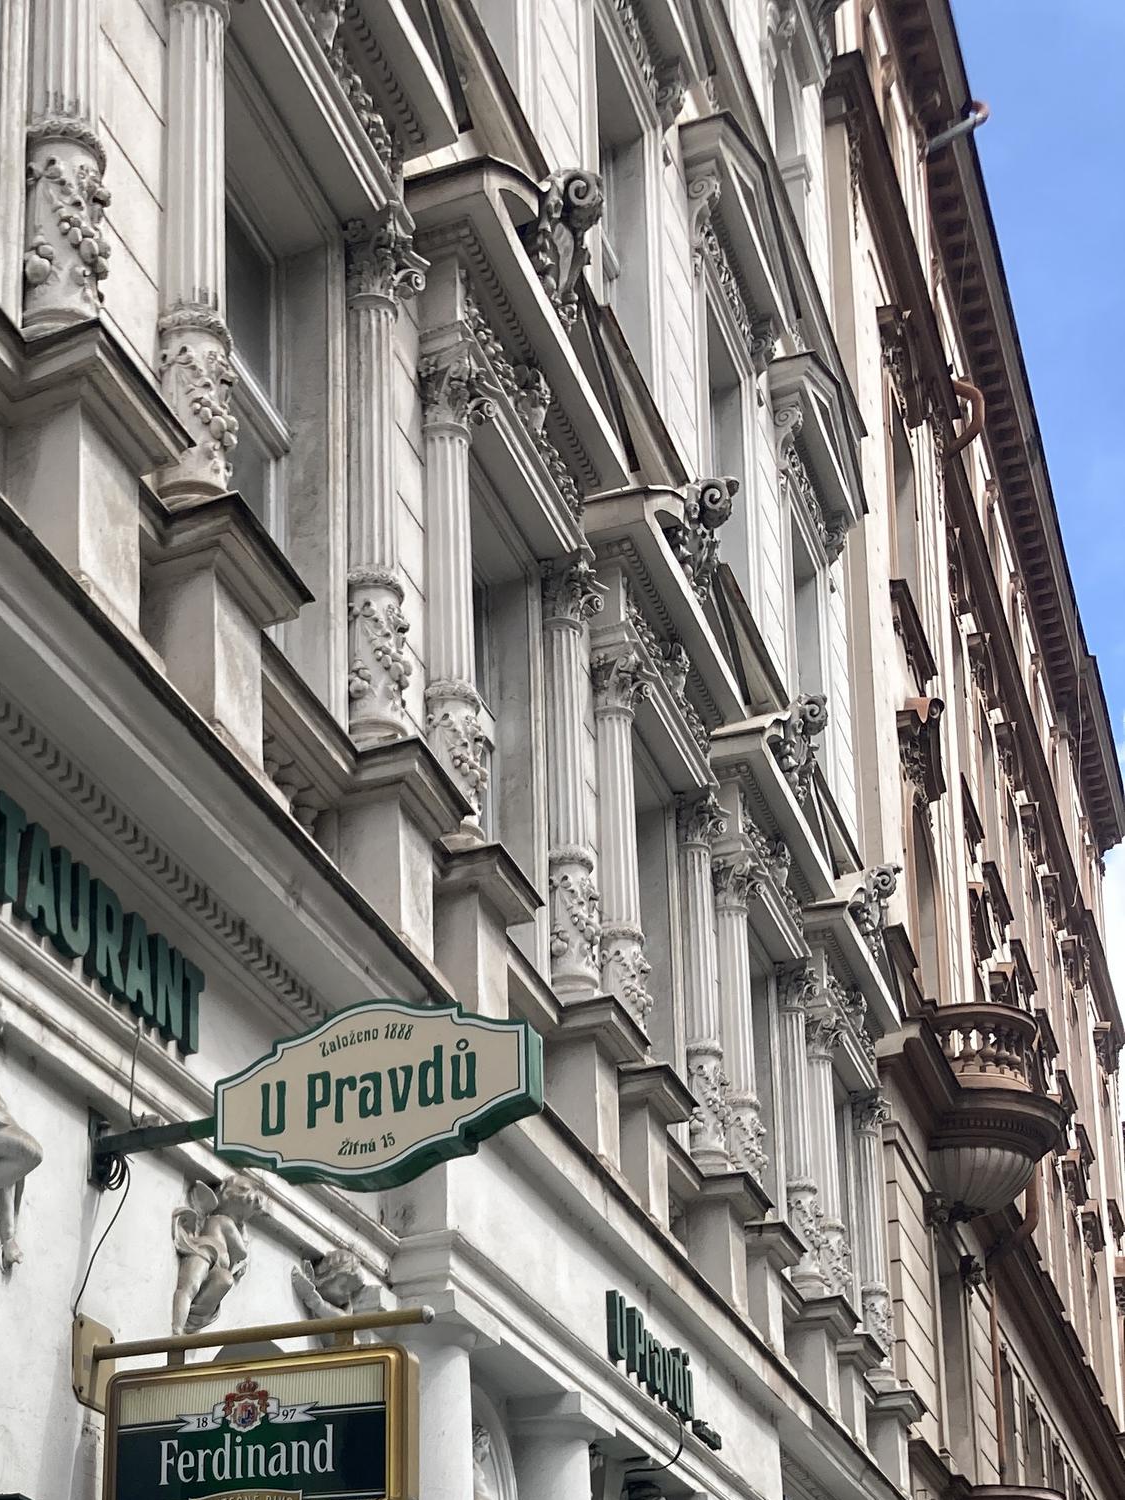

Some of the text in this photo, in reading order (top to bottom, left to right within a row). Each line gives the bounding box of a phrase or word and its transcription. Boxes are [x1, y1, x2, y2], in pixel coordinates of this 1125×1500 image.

[318, 1027, 379, 1058] Založeno
[260, 1038, 477, 1136] U Pravdů
[337, 1131, 396, 1157] Žitná 15
[606, 1289, 628, 1361] U
[196, 1416, 209, 1429] 18
[281, 1407, 297, 1421] 97
[158, 1423, 336, 1487] Ferdinand
